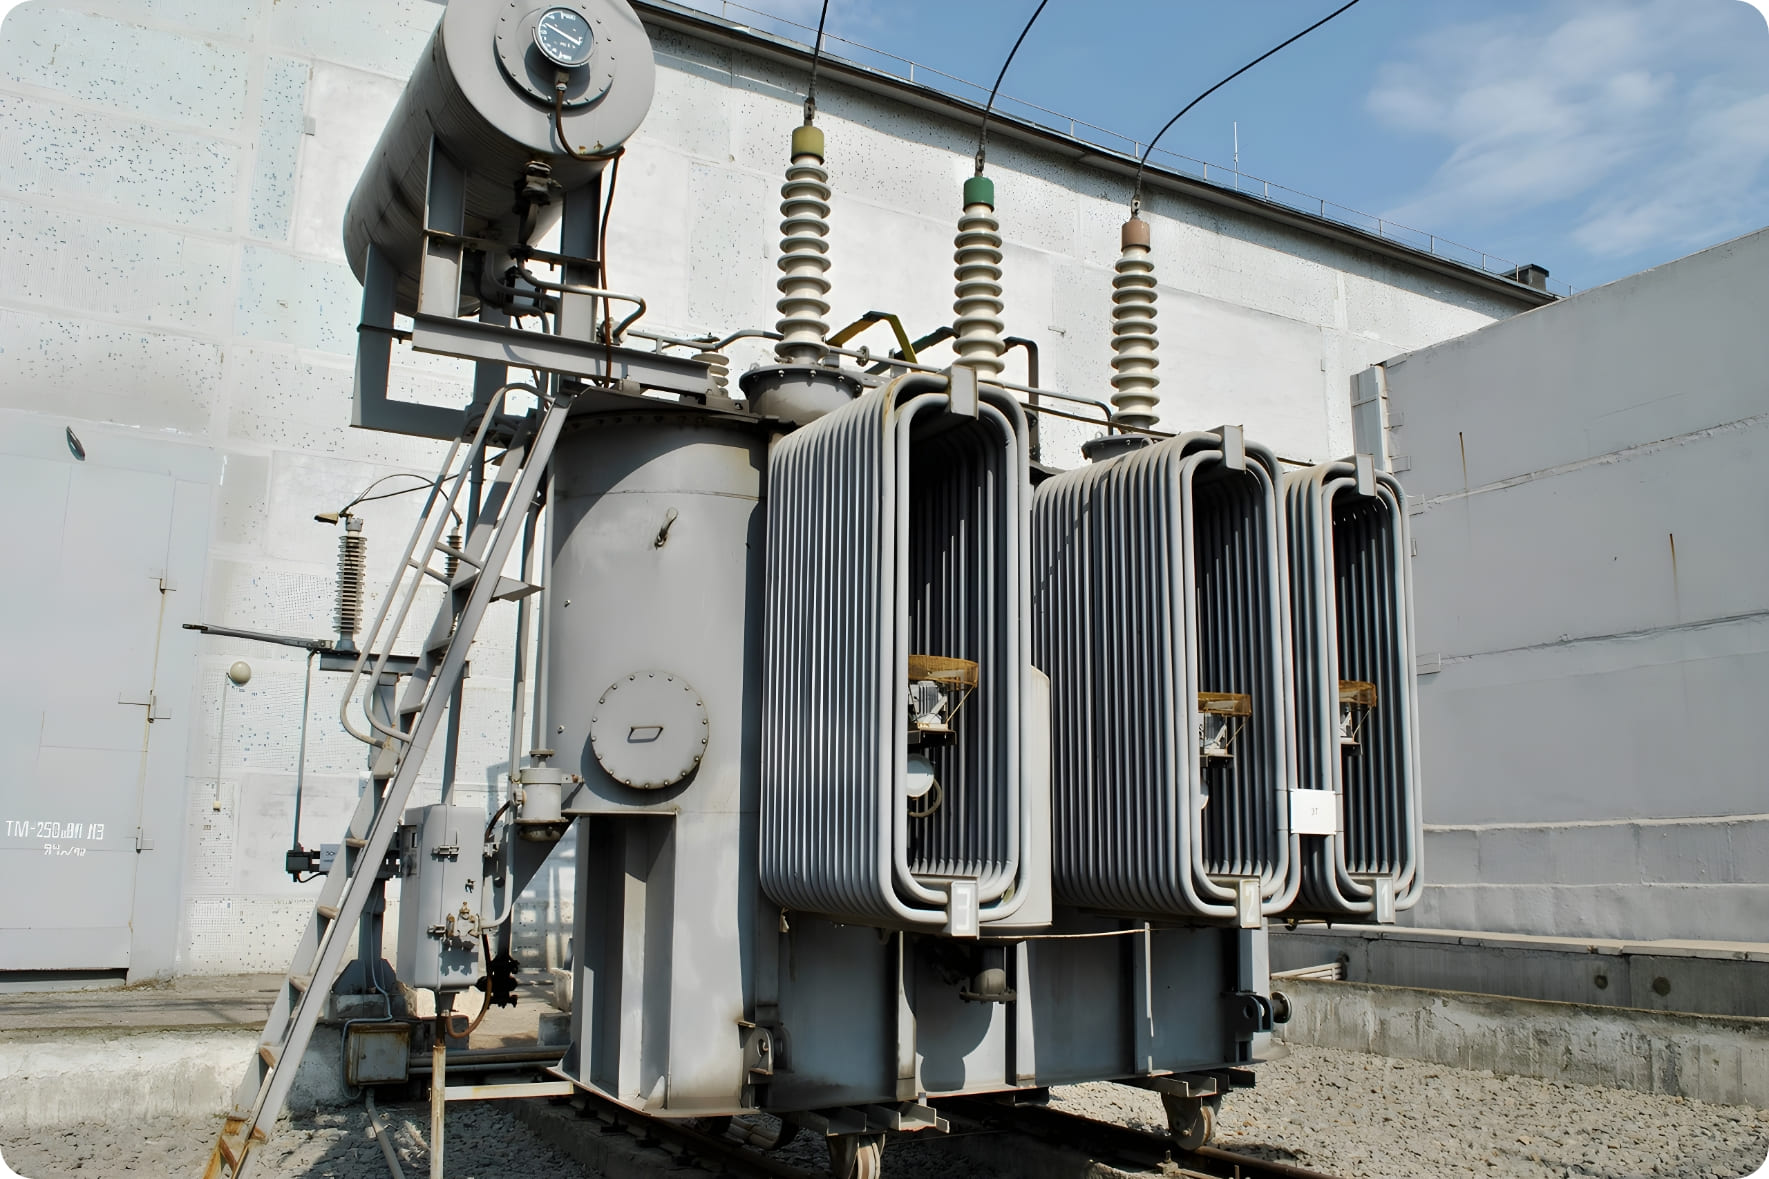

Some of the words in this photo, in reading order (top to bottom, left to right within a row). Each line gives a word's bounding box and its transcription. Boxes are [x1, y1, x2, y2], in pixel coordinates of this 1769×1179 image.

[956, 887, 971, 930] 3
[1246, 884, 1256, 923] 2
[1381, 881, 1389, 919] 1
